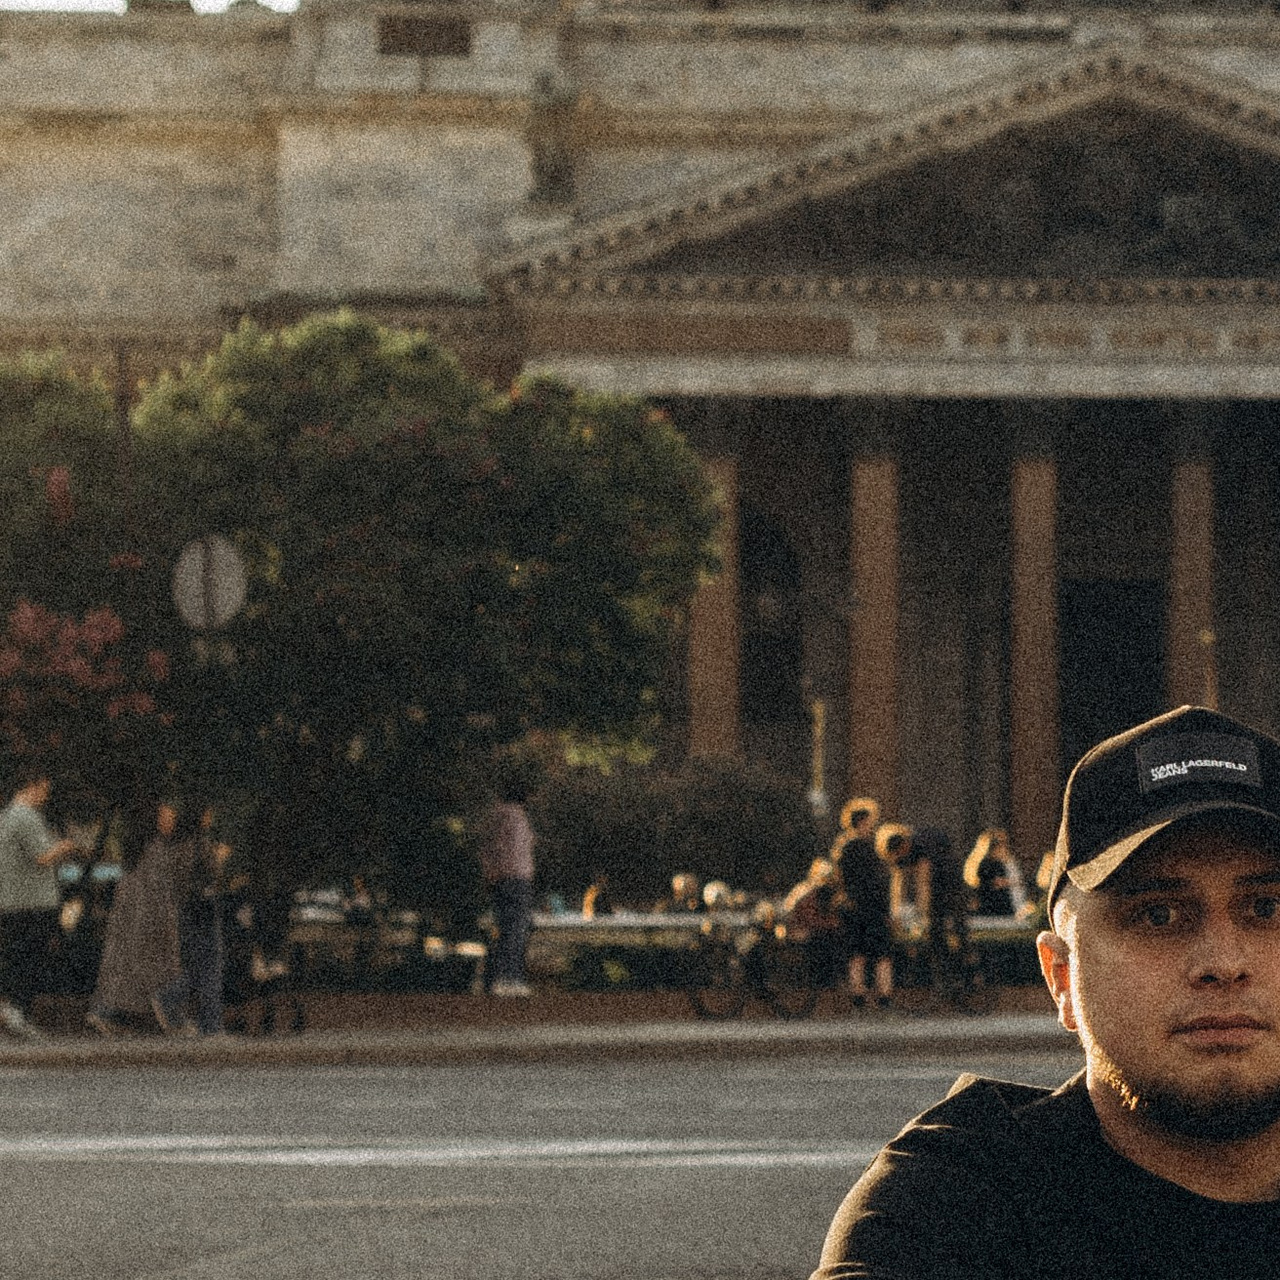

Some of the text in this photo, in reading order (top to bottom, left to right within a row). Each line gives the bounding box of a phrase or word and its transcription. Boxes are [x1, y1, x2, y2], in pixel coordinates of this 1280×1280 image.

[1151, 760, 1247, 774] KARL LAGERFELD
[1151, 767, 1188, 781] JEANS
